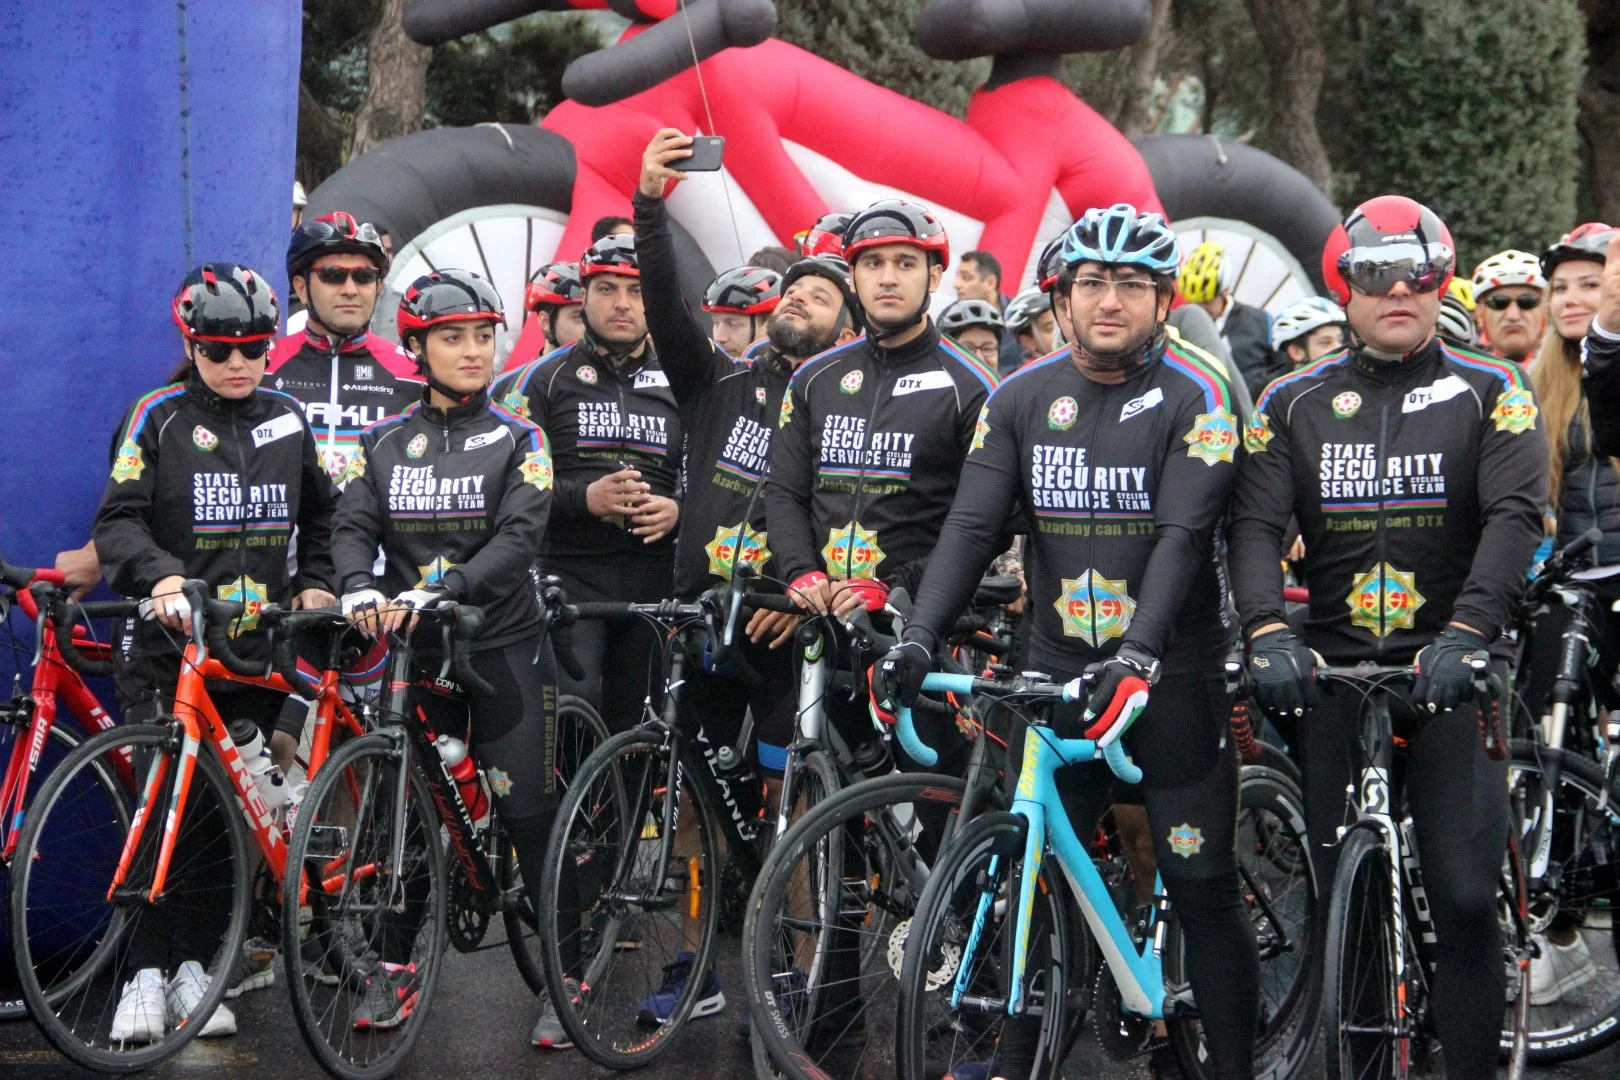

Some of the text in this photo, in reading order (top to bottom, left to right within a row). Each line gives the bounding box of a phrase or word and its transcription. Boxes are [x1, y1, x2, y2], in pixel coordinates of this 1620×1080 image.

[285, 380, 327, 388] SYNERGY
[350, 384, 394, 394] AtaHolding
[299, 402, 385, 426] AKU
[578, 402, 618, 412] STATE
[736, 416, 772, 440] STATE
[824, 414, 866, 432] STATE
[578, 425, 640, 440] SERVICE
[646, 435, 667, 445] TEAM
[820, 447, 881, 465] SERVICE
[1032, 444, 1086, 466] STATE
[1322, 442, 1375, 459] STATE
[886, 458, 910, 468] TEAM
[194, 473, 240, 487] STATE
[392, 464, 434, 480] STATE
[1116, 492, 1148, 500] CYCLING
[1320, 478, 1404, 498] SERVICE
[1411, 483, 1444, 494] TEAM
[388, 496, 452, 511] SERVICE
[458, 500, 484, 509] TEAM
[1032, 488, 1110, 509] SERVICE
[1117, 500, 1150, 510] TEAM
[194, 504, 262, 522] SERVICE
[267, 508, 288, 518] TEAM
[218, 735, 283, 849] TREK
[672, 760, 682, 830] VILANO
[764, 990, 790, 1039] DT SWISS
[1545, 1031, 1588, 1048] JACK
